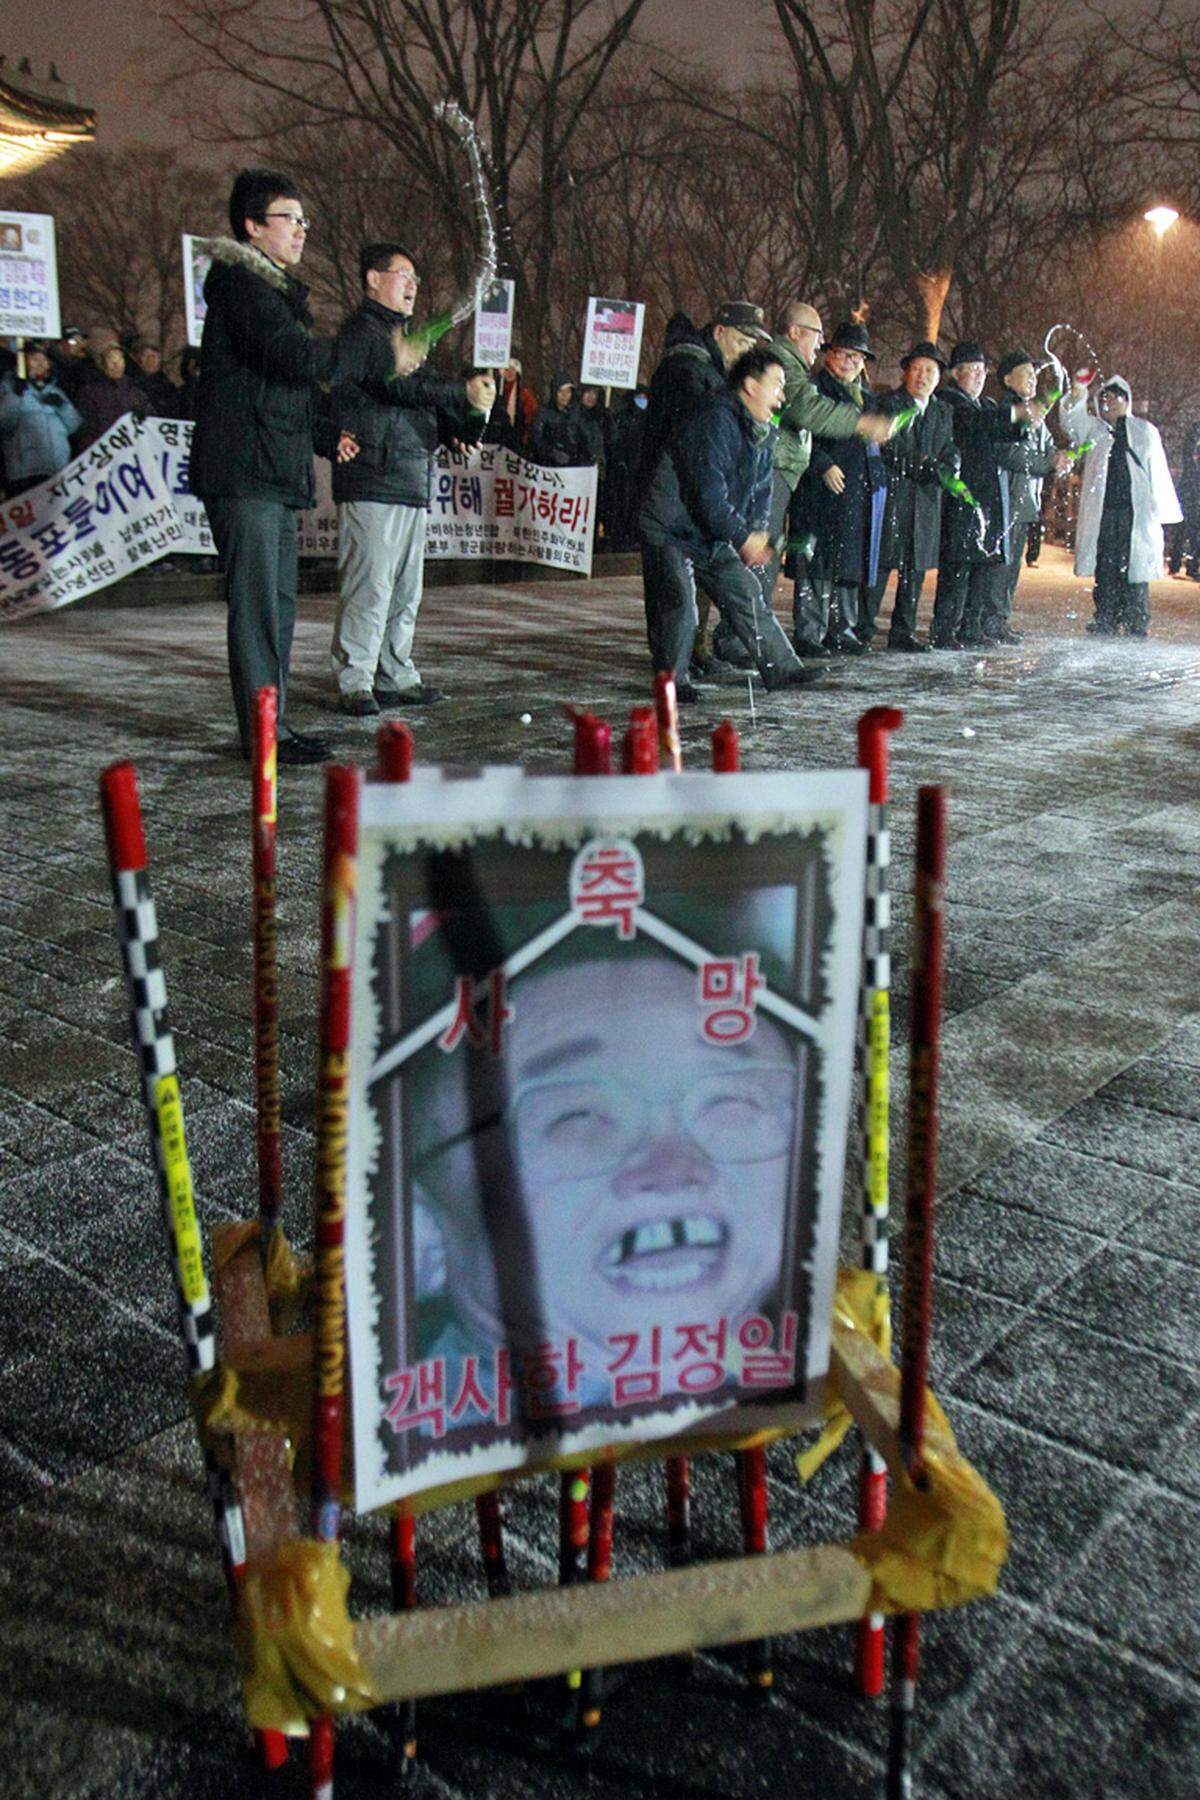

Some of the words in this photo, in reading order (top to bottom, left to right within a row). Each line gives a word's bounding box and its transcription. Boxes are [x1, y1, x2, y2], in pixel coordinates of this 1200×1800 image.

[436, 474, 483, 516] 위해
[493, 477, 591, 535] 궐기하라!
[480, 450, 495, 471] 안
[505, 453, 566, 489] 남았다!
[574, 846, 642, 939] 축
[698, 953, 766, 1045] 망
[382, 1336, 587, 1438] 객사한
[604, 1312, 799, 1407] 김정일
